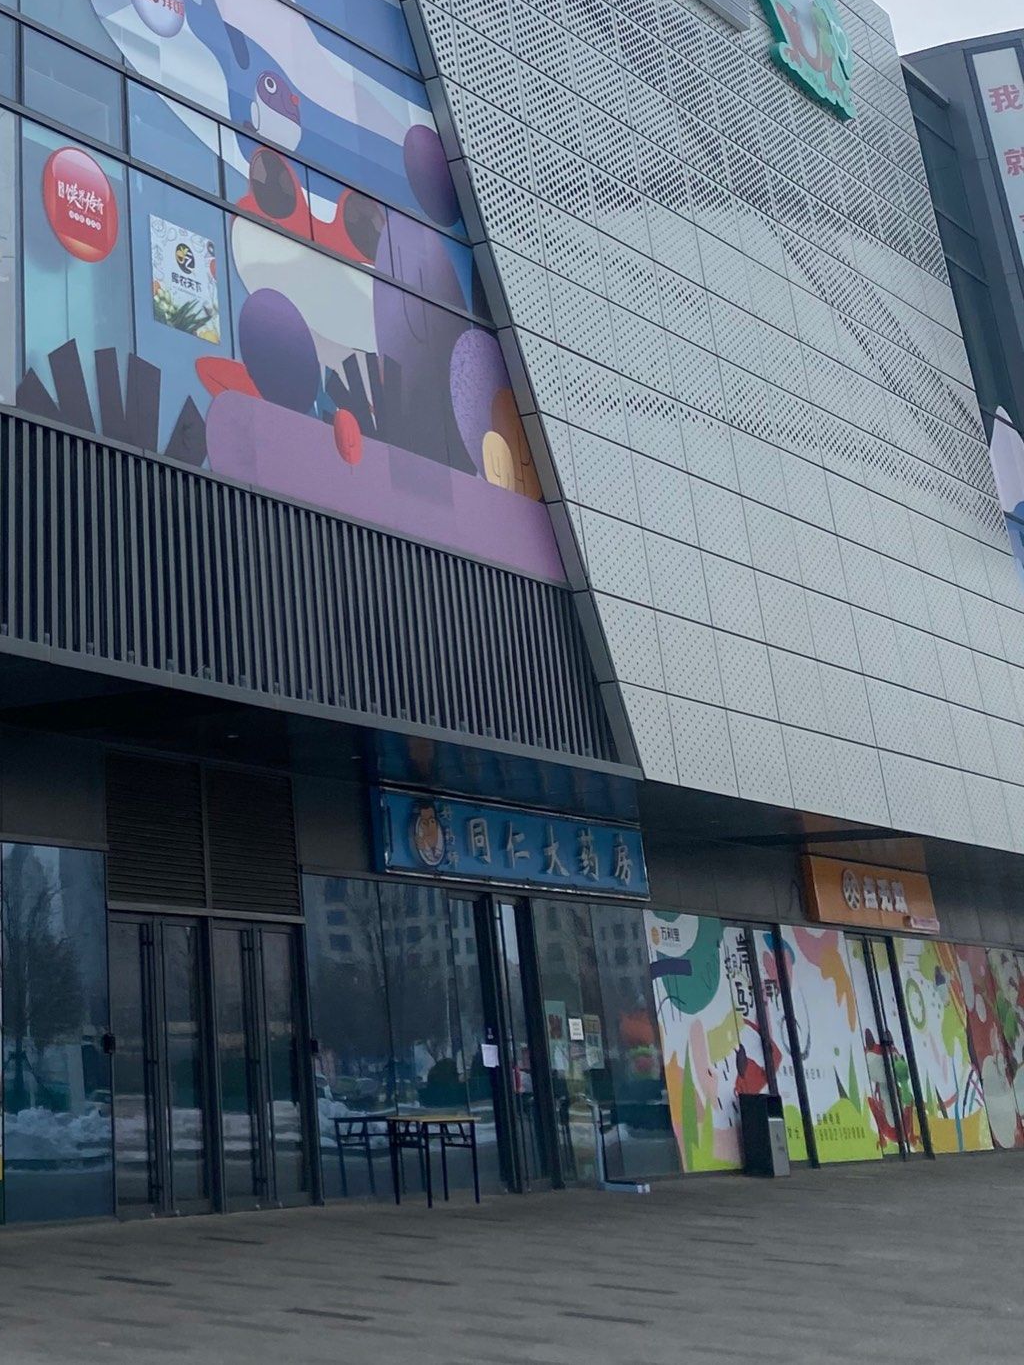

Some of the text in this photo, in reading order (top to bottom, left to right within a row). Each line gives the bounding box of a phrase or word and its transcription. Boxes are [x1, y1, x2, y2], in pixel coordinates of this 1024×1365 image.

[469, 818, 634, 885] 同仁大药房
